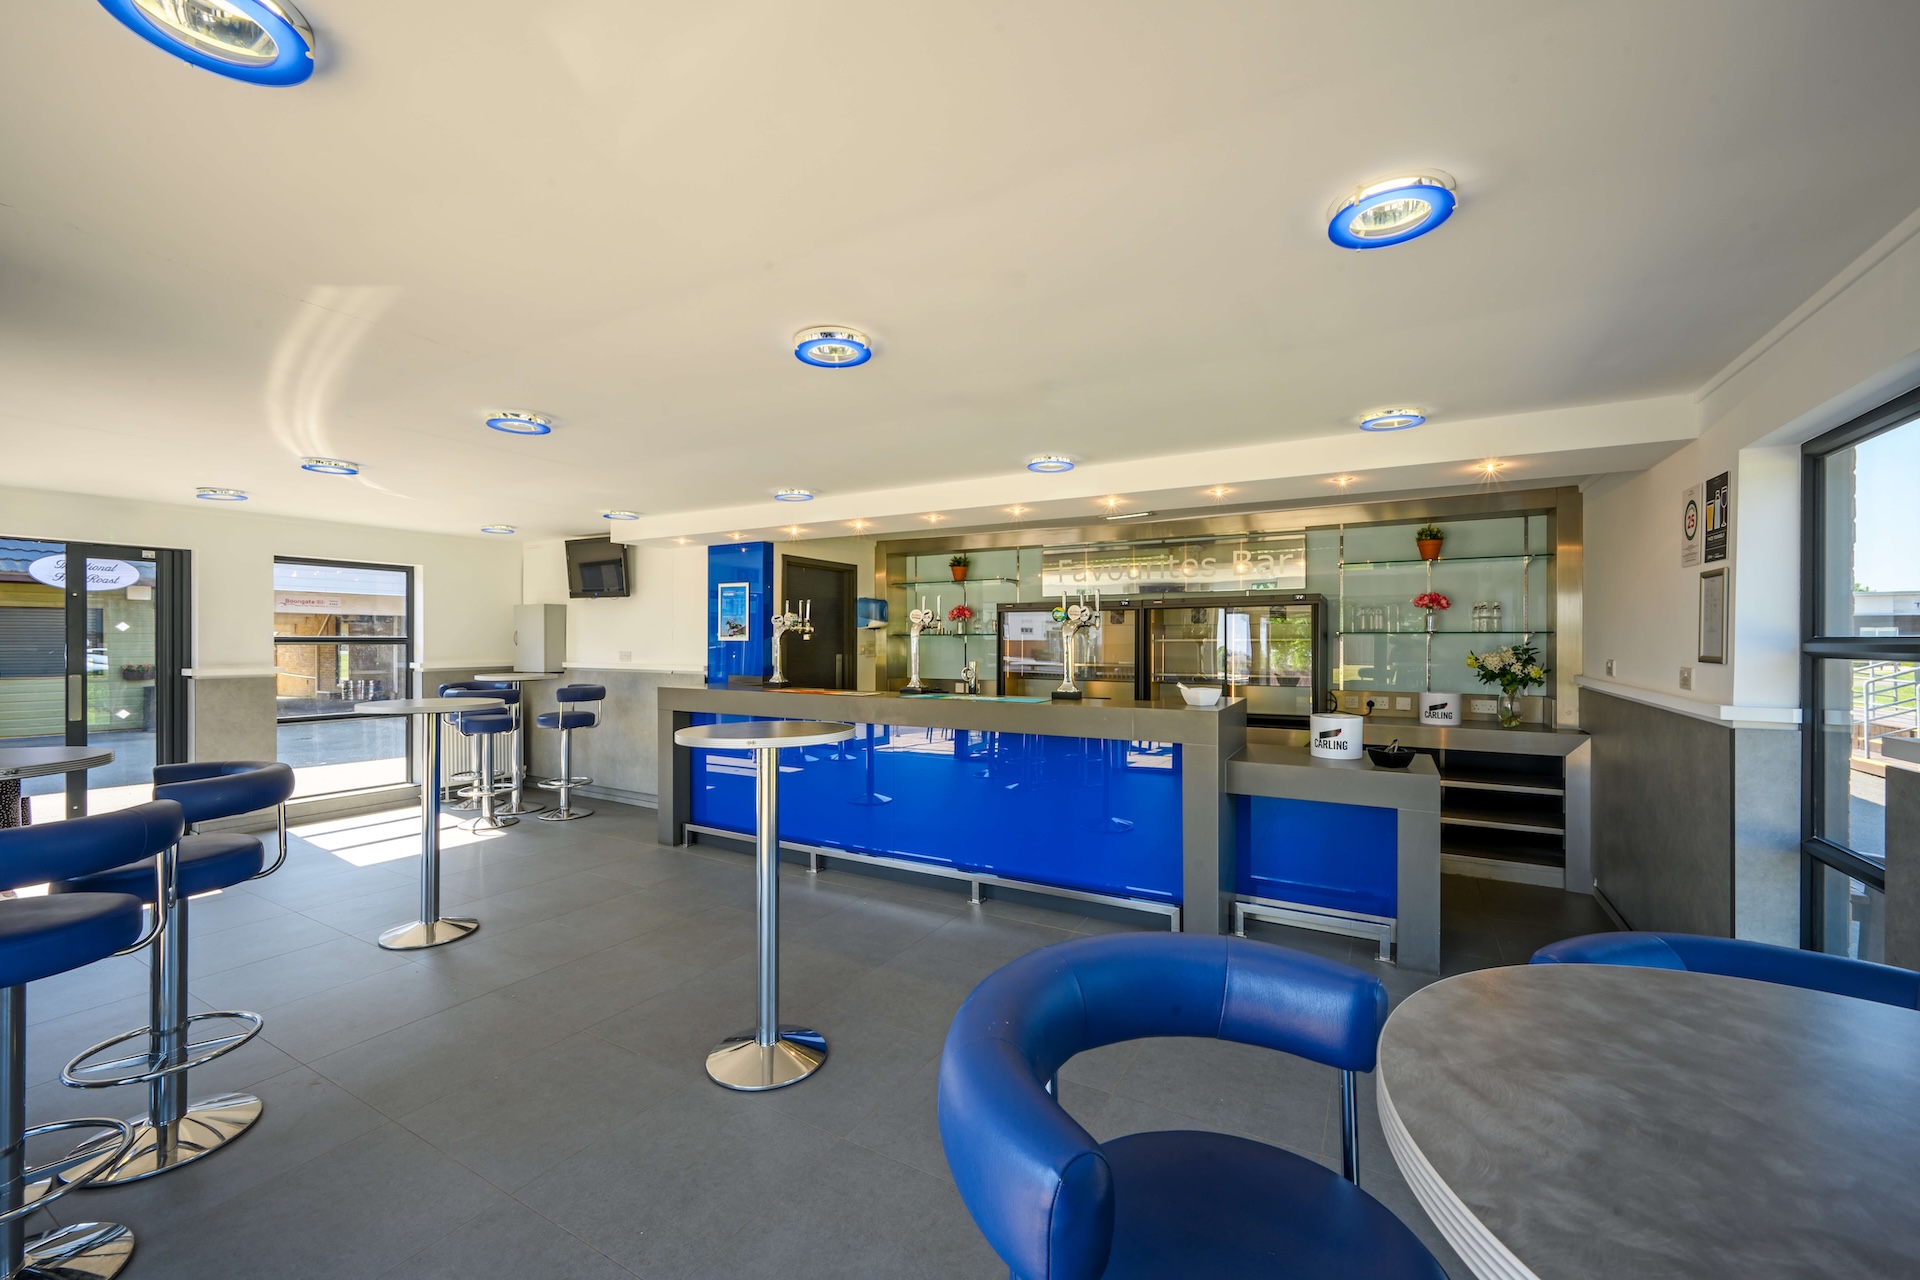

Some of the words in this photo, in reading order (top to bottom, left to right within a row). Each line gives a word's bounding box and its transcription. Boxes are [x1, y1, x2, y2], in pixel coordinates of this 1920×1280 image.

[1687, 514, 1695, 529] 25
[1058, 554, 1217, 583] Favourites
[1232, 549, 1293, 576] Bar
[87, 573, 120, 584] Roast
[1424, 710, 1453, 720] CARLING
[1314, 738, 1348, 751] CARLING
